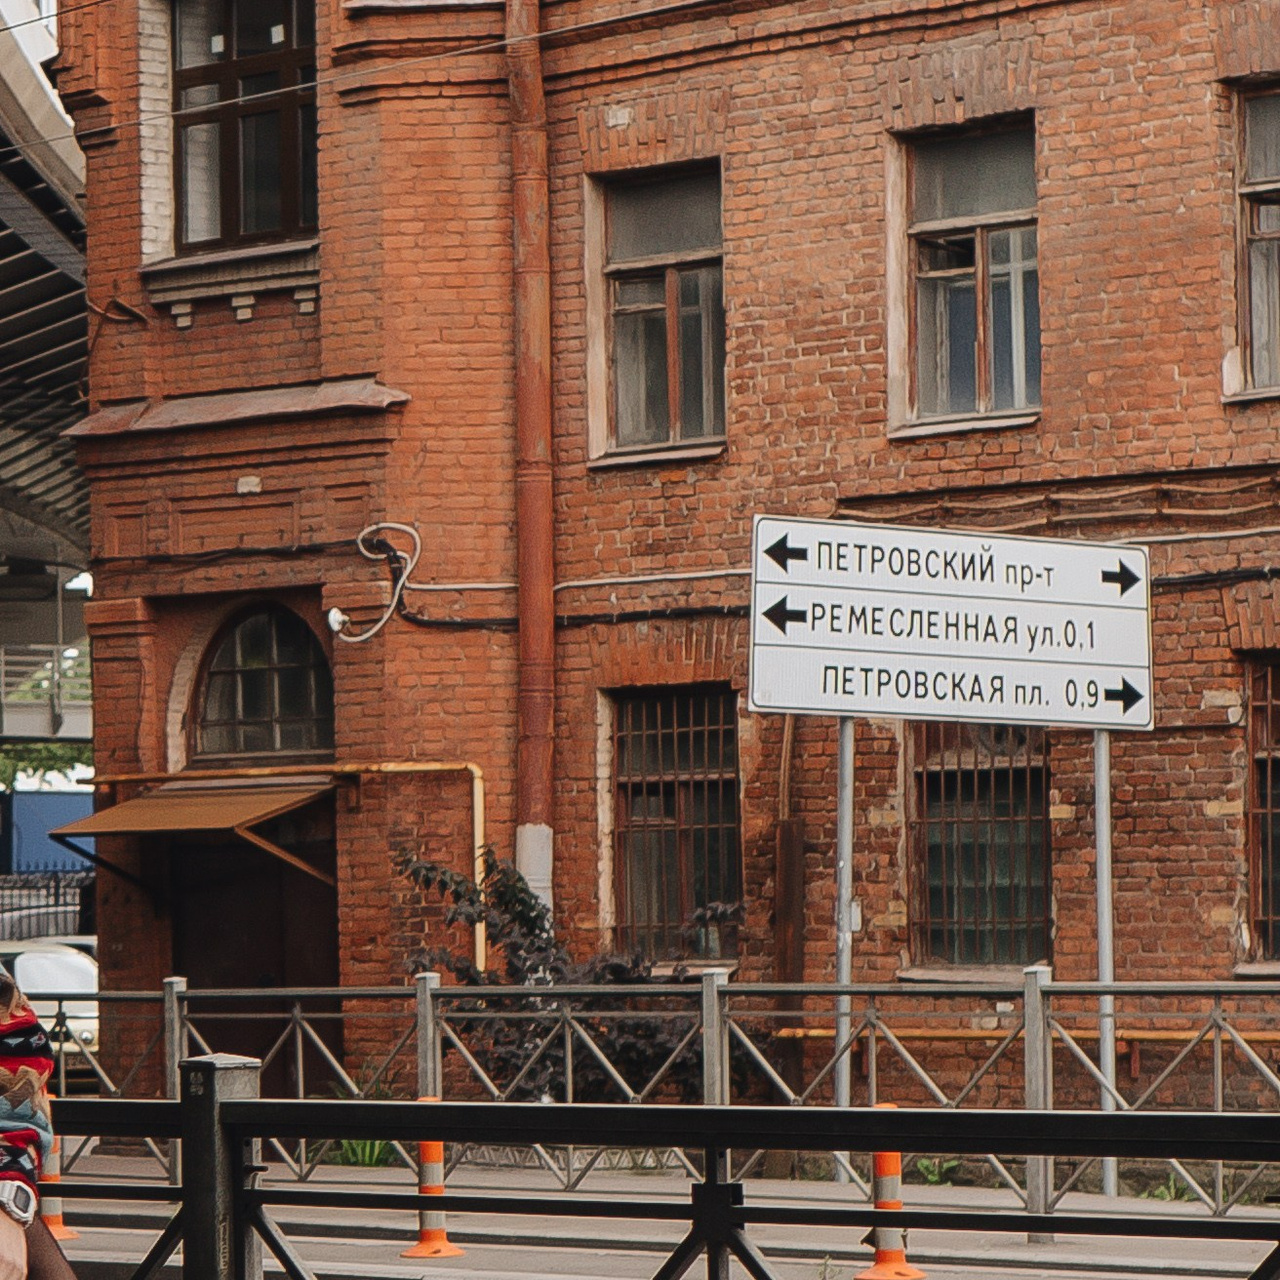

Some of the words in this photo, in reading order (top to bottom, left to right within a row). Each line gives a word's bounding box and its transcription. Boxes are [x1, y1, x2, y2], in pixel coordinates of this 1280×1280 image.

[817, 541, 995, 583] ПЕТРОВСКИЙ
[1005, 564, 1055, 593] пр-т
[811, 603, 1018, 645] РЕМЕСЛЕННАЯ
[822, 665, 1005, 704] ПЕТРОВСКАЯ
[1014, 684, 1050, 706] пл.
[1065, 678, 1099, 711] 0,9
